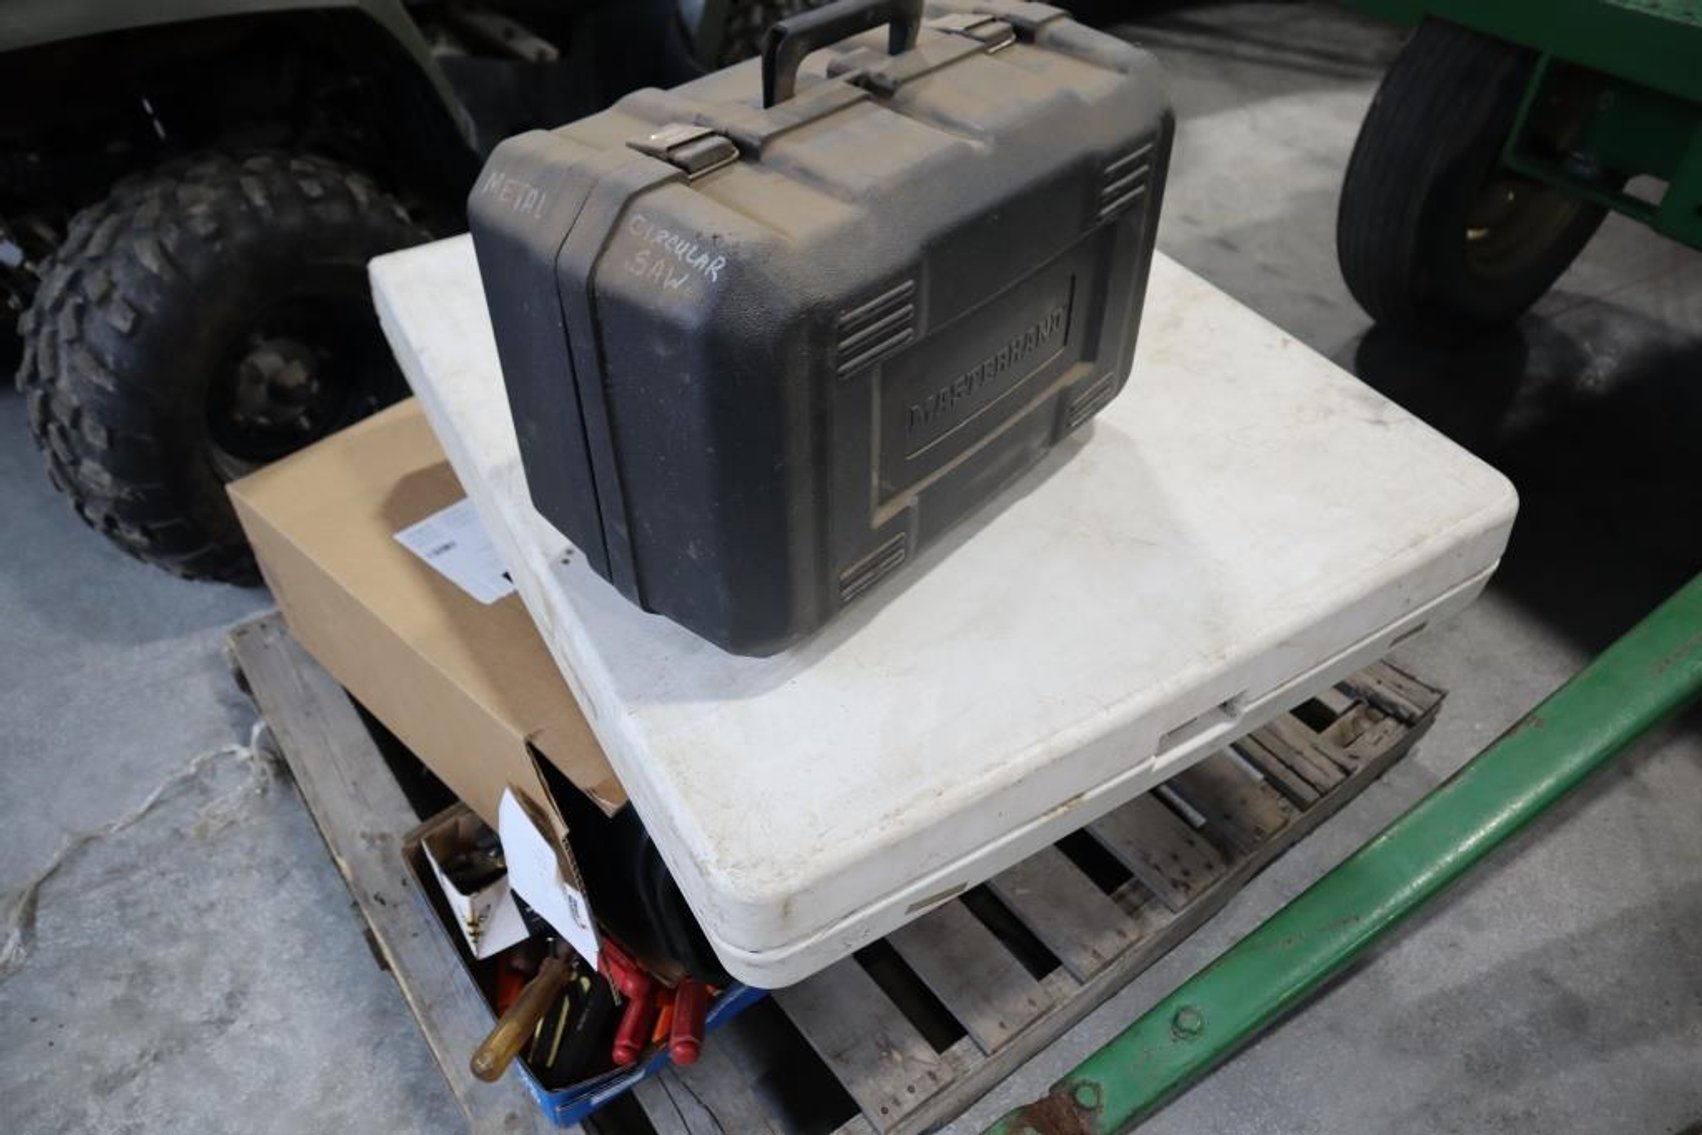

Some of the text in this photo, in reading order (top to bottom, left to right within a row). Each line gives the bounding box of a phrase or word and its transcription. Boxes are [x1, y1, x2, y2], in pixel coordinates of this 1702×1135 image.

[482, 172, 547, 219] METAL
[628, 213, 727, 283] CIRCULAR
[628, 249, 690, 290] SAW
